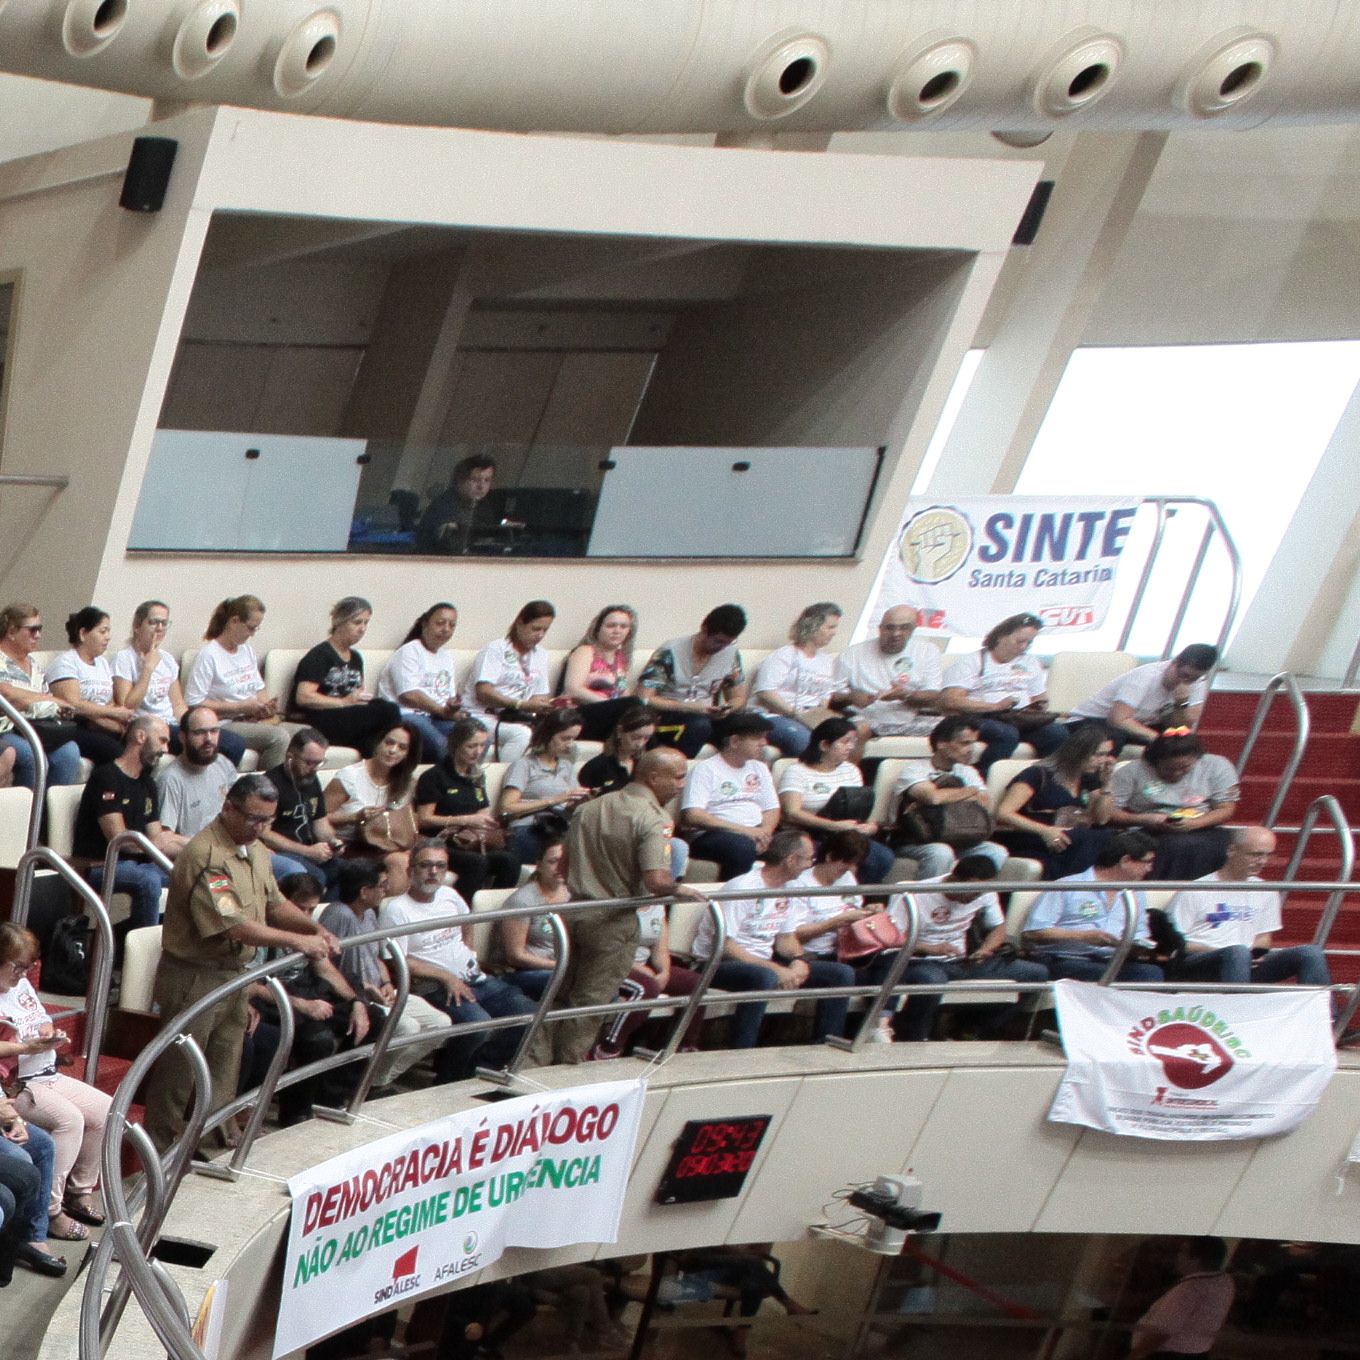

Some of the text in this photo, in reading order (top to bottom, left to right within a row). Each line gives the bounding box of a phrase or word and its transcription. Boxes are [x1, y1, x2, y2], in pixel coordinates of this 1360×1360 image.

[978, 507, 1138, 564] SINTE
[968, 569, 1027, 588] Santa
[302, 1103, 620, 1238] DEMOCRACIA É DIÁLOGO
[292, 1236, 338, 1289] NÃO
[336, 1225, 369, 1266] AO
[367, 1191, 451, 1251] REGIME
[452, 1180, 486, 1219] DE
[433, 1252, 483, 1282] AFALESC
[374, 1274, 422, 1304] SINDALESC
